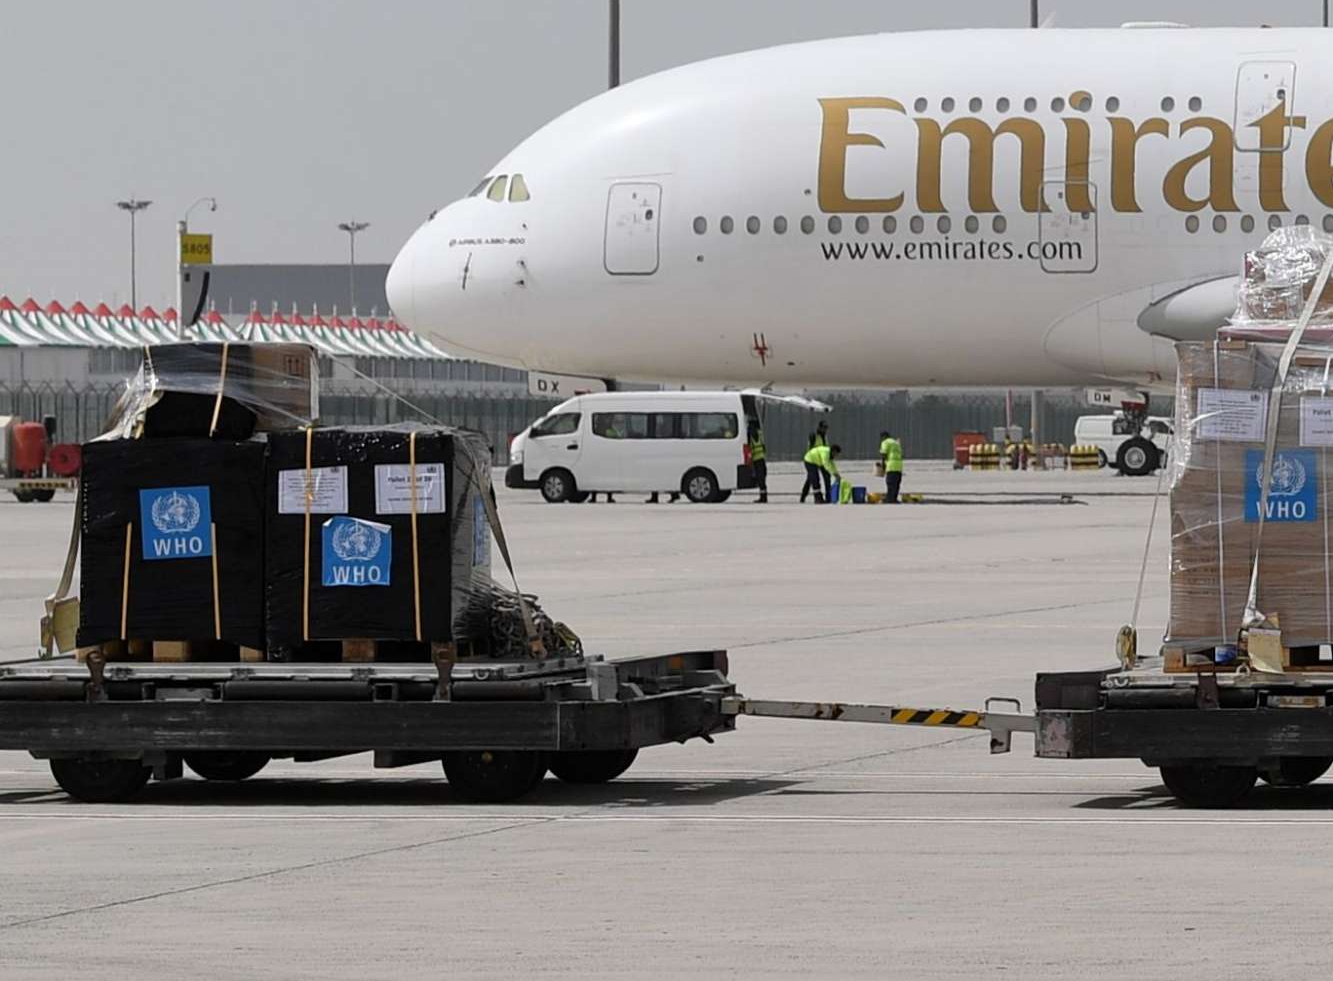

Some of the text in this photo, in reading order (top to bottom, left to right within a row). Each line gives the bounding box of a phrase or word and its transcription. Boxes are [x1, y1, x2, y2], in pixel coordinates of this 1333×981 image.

[820, 236, 1082, 260] www.emirates.com
[537, 379, 560, 394] DX
[1256, 501, 1306, 519] WHO
[153, 536, 203, 556] WHO
[333, 566, 381, 583] WHO
